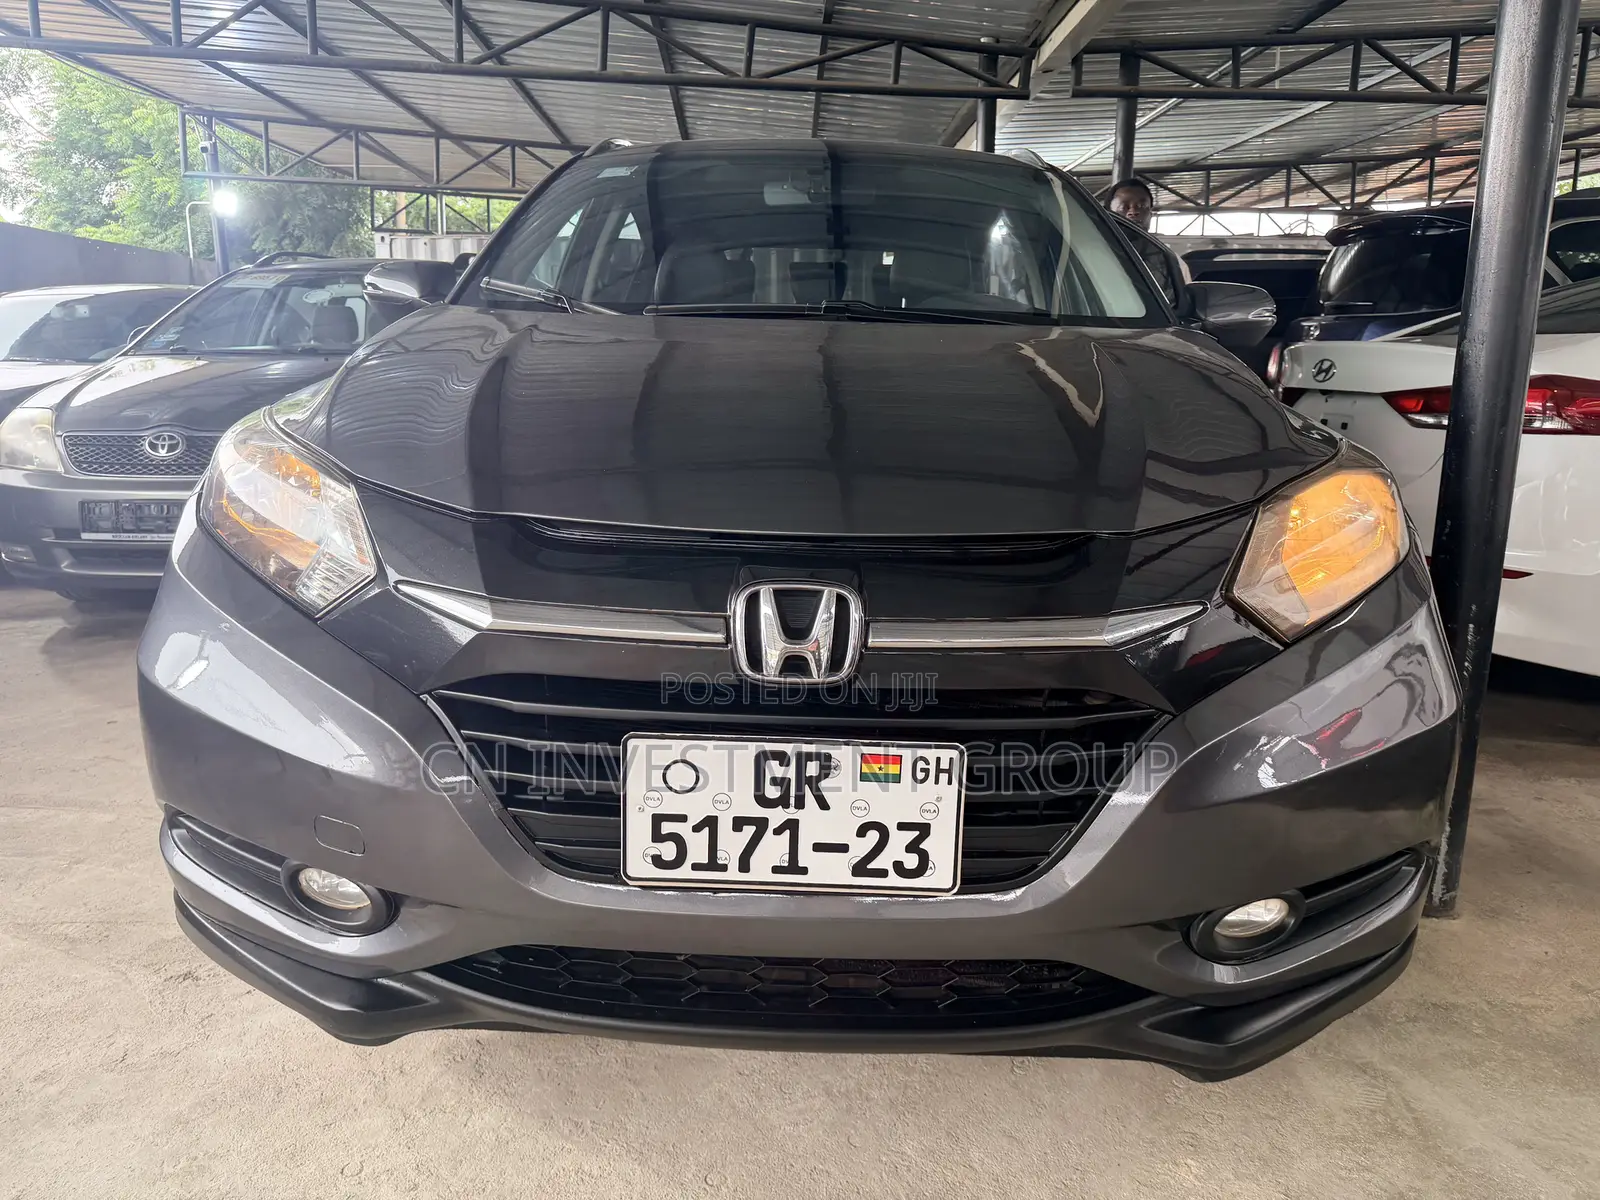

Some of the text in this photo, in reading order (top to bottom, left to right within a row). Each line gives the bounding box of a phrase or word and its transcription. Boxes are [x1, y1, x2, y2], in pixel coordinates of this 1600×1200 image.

[753, 750, 954, 811] GR GH
[645, 795, 661, 803] DVLA
[714, 798, 731, 806] DVLA
[852, 804, 868, 812] DVLA
[921, 807, 937, 815] DVLA
[651, 813, 932, 879] 5171-23
